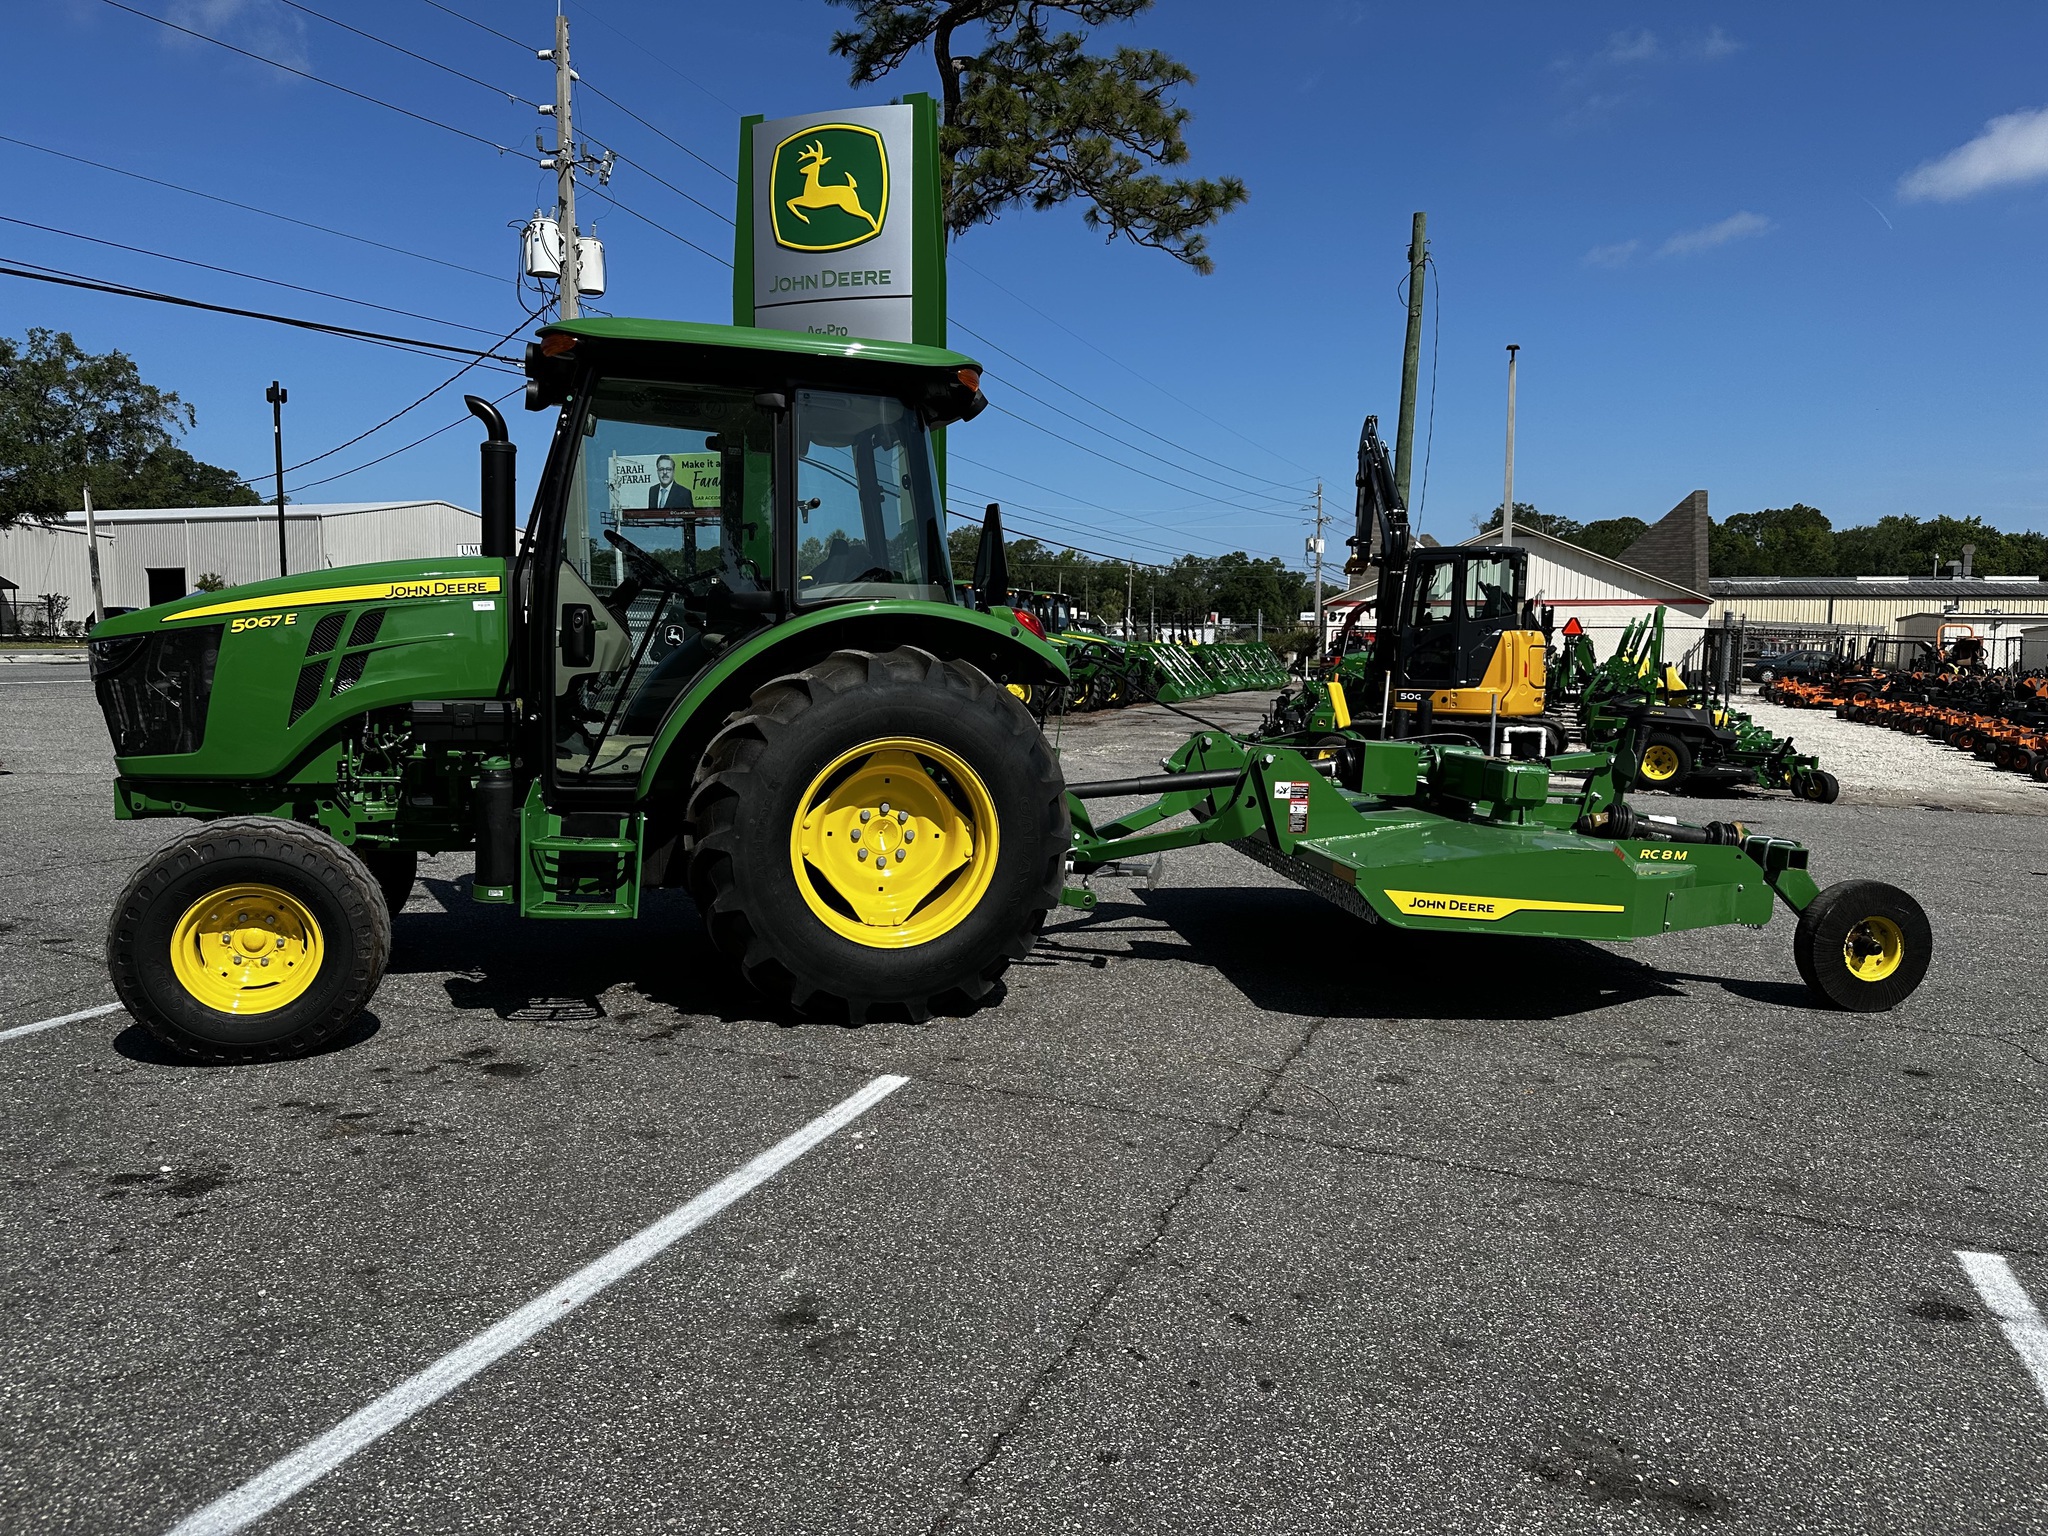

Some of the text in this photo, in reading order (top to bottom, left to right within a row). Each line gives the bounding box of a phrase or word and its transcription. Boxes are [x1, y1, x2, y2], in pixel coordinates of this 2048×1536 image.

[769, 269, 892, 293] JOHN DEERE
[807, 323, 848, 337] Ag-Pro
[681, 460, 705, 469] Make
[707, 459, 713, 467] it
[621, 474, 651, 484] FARAH
[692, 471, 722, 490] Fara
[385, 582, 487, 598] JOHN DEERE
[1409, 897, 1495, 913] JOHN DEERE
